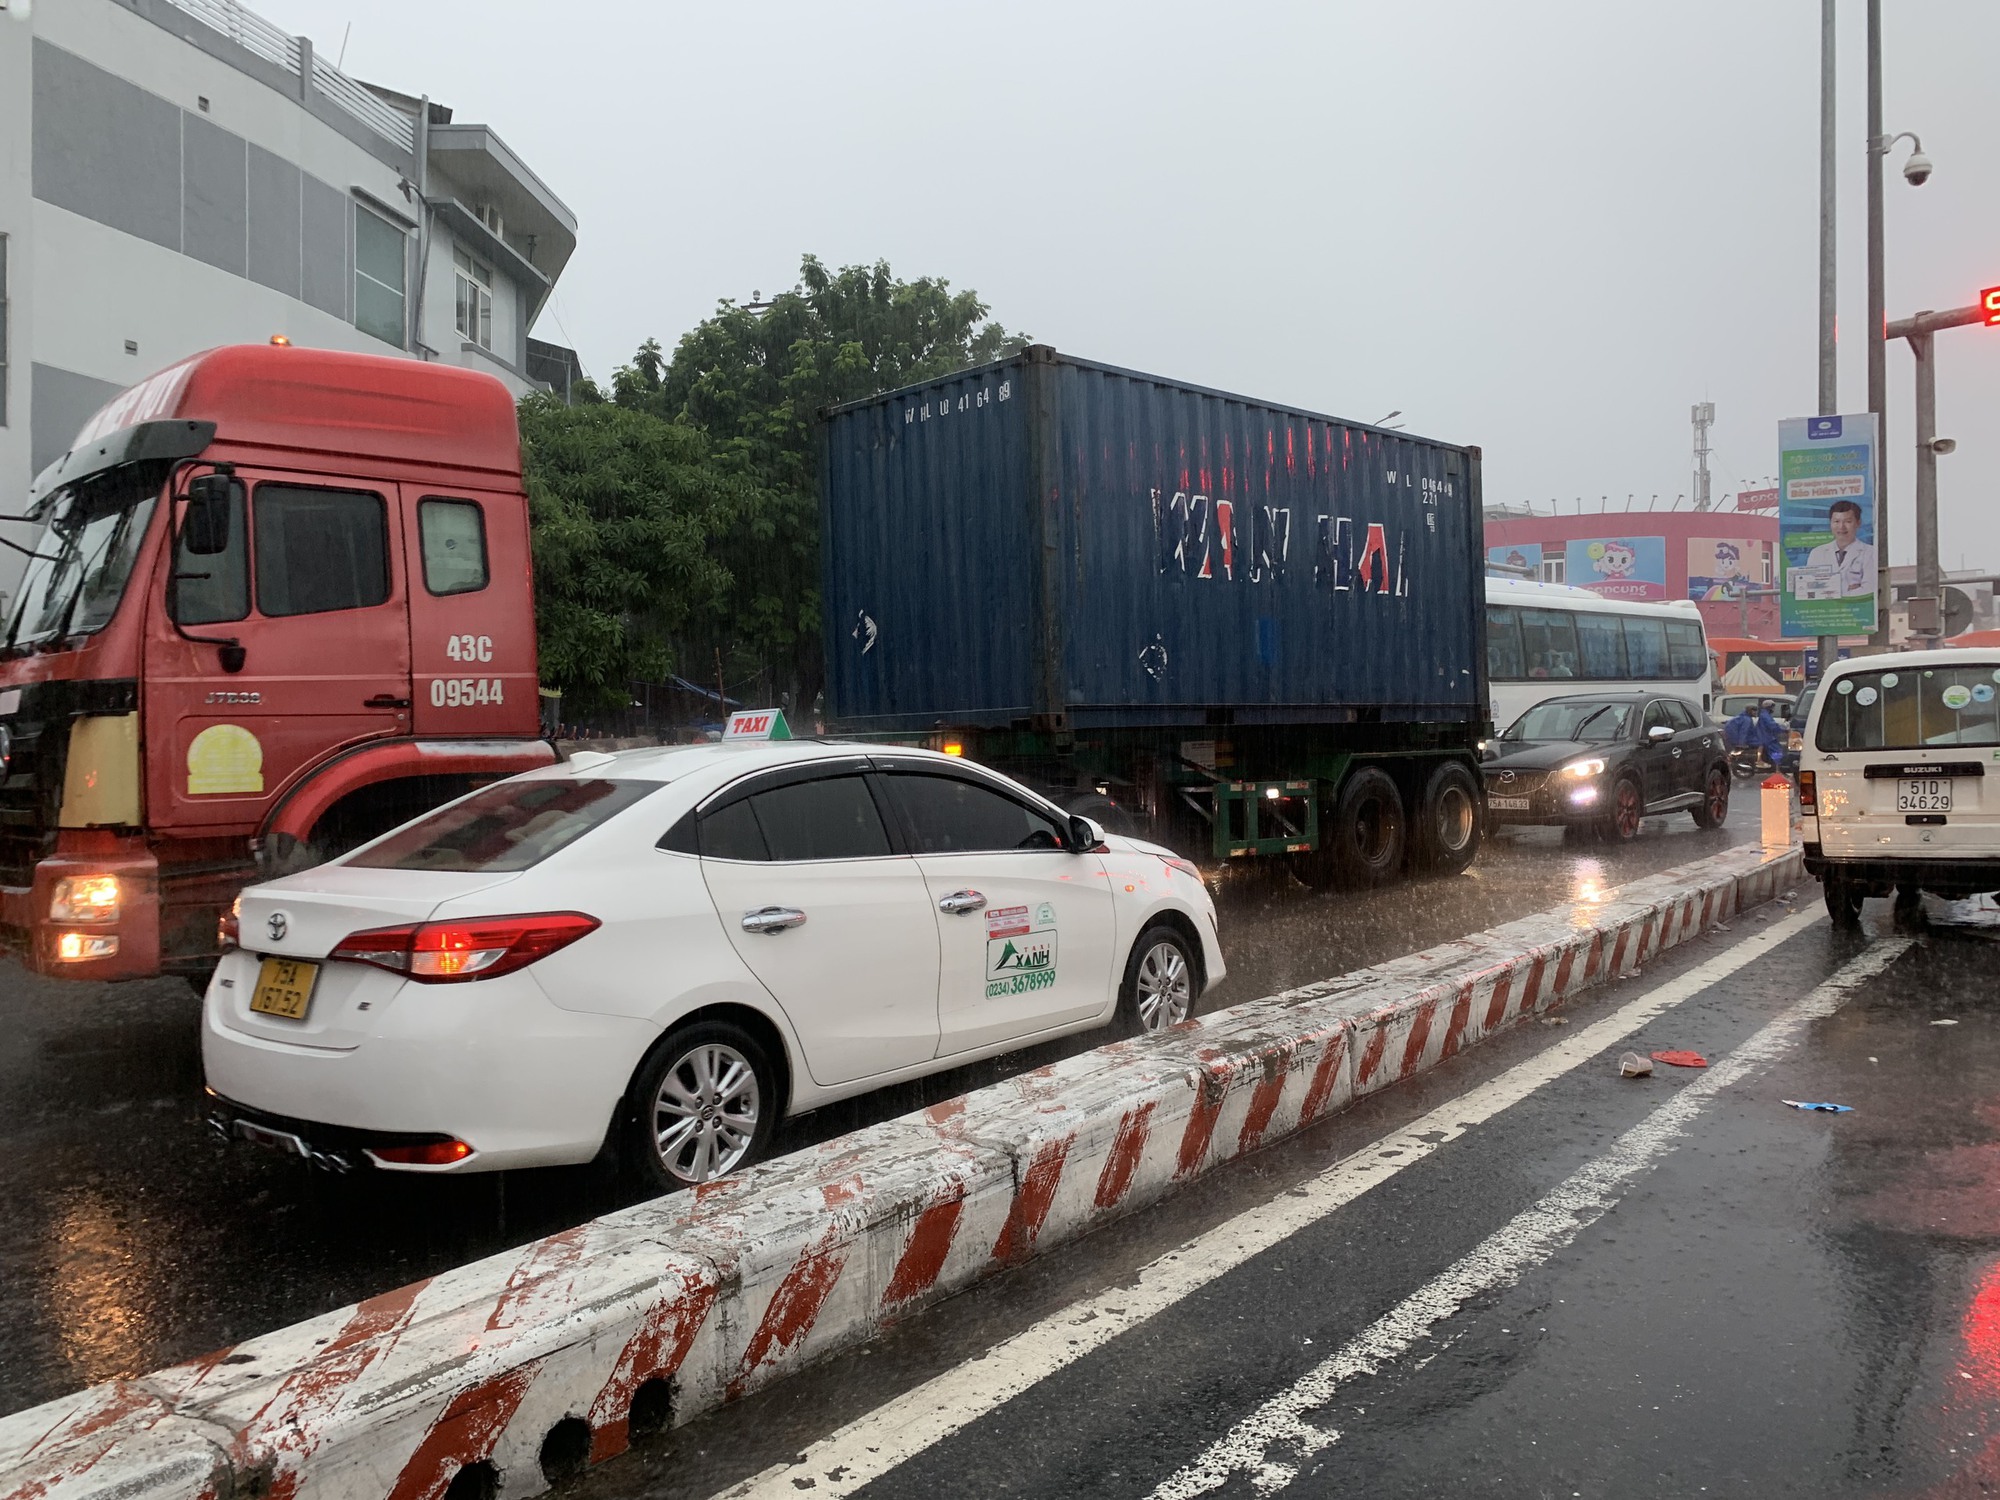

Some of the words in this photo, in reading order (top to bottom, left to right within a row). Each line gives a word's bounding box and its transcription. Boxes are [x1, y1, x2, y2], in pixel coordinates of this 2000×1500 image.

[446, 634, 493, 663] 43C
[430, 679, 504, 707] 09544
[733, 716, 770, 734] TAXI
[1910, 780, 1939, 795] 51D
[1899, 795, 1950, 810] 346.29
[1024, 943, 1050, 953] TAXI
[1016, 949, 1050, 968] XANH
[985, 981, 1010, 998] (0234)
[1010, 970, 1056, 995] 3678999
